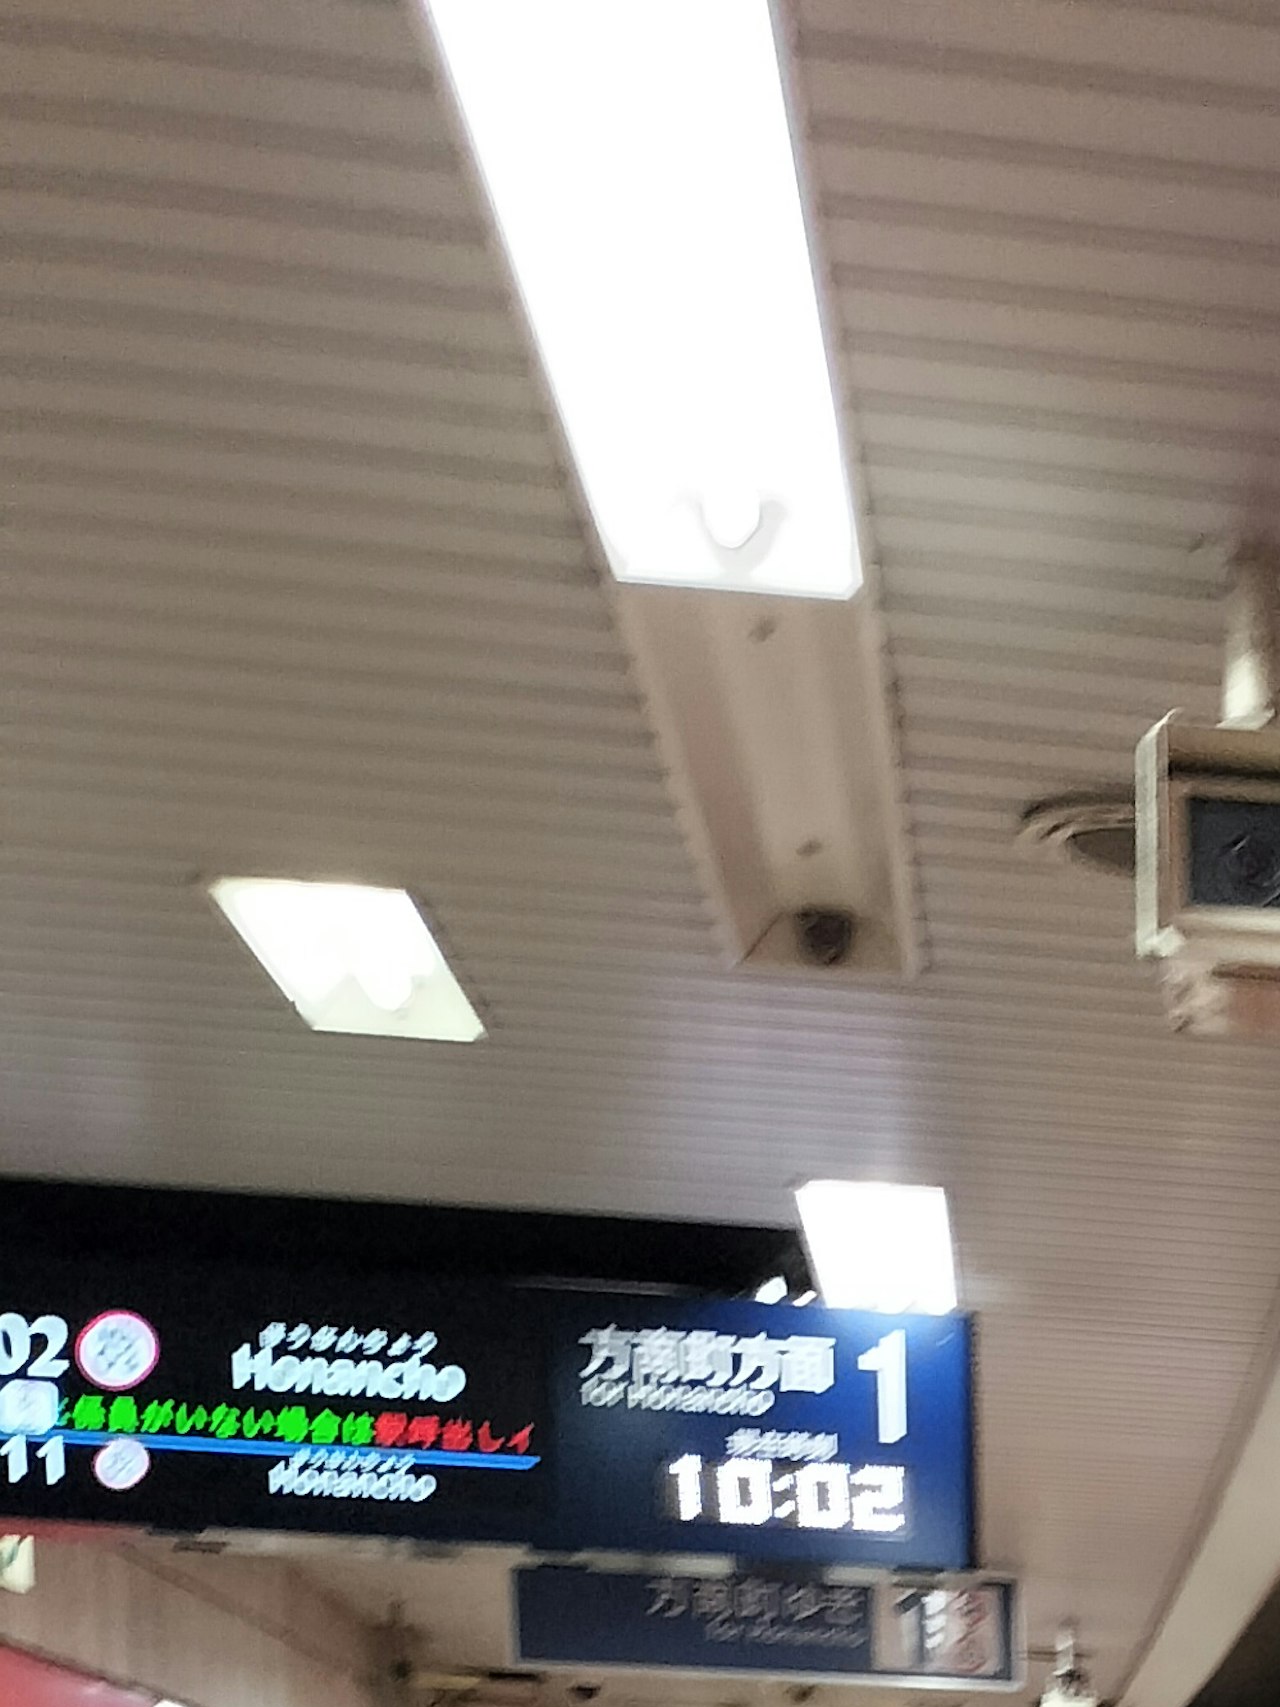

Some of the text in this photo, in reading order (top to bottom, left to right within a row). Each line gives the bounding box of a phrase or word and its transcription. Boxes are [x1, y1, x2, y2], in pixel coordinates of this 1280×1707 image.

[231, 1342, 467, 1402] Honancho
[579, 1322, 838, 1394] 方南町方面
[857, 1328, 908, 1444] 1
[0, 1434, 66, 1486] 11
[268, 1460, 437, 1502] Honancho
[667, 1451, 906, 1533] 10:02
